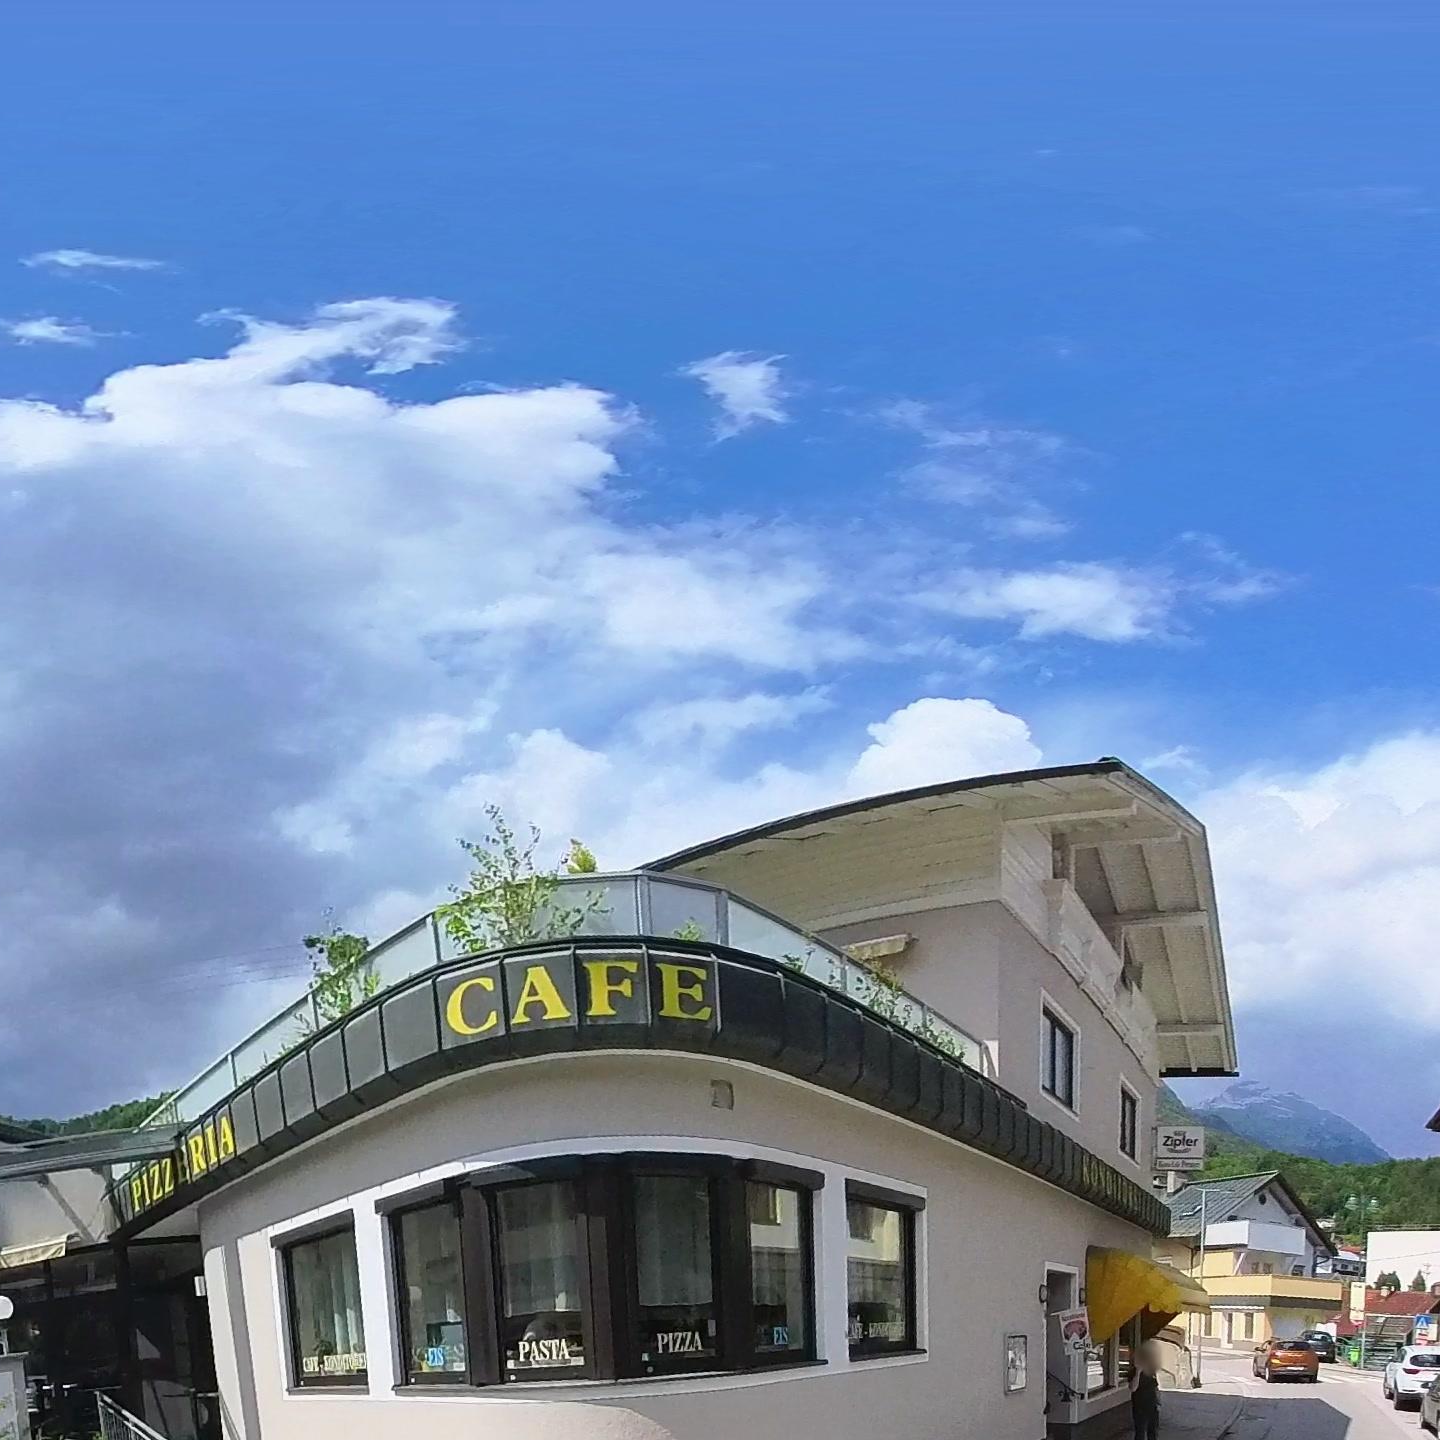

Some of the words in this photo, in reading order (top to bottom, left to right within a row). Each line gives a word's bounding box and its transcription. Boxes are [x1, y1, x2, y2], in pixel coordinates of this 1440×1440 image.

[446, 960, 713, 1036] CAFE
[131, 1115, 236, 1213] PIZZRIA
[656, 1331, 703, 1354] PIZZA
[772, 1326, 789, 1346] EIS
[426, 1347, 445, 1367] EIS
[517, 1338, 572, 1362] PASTA
